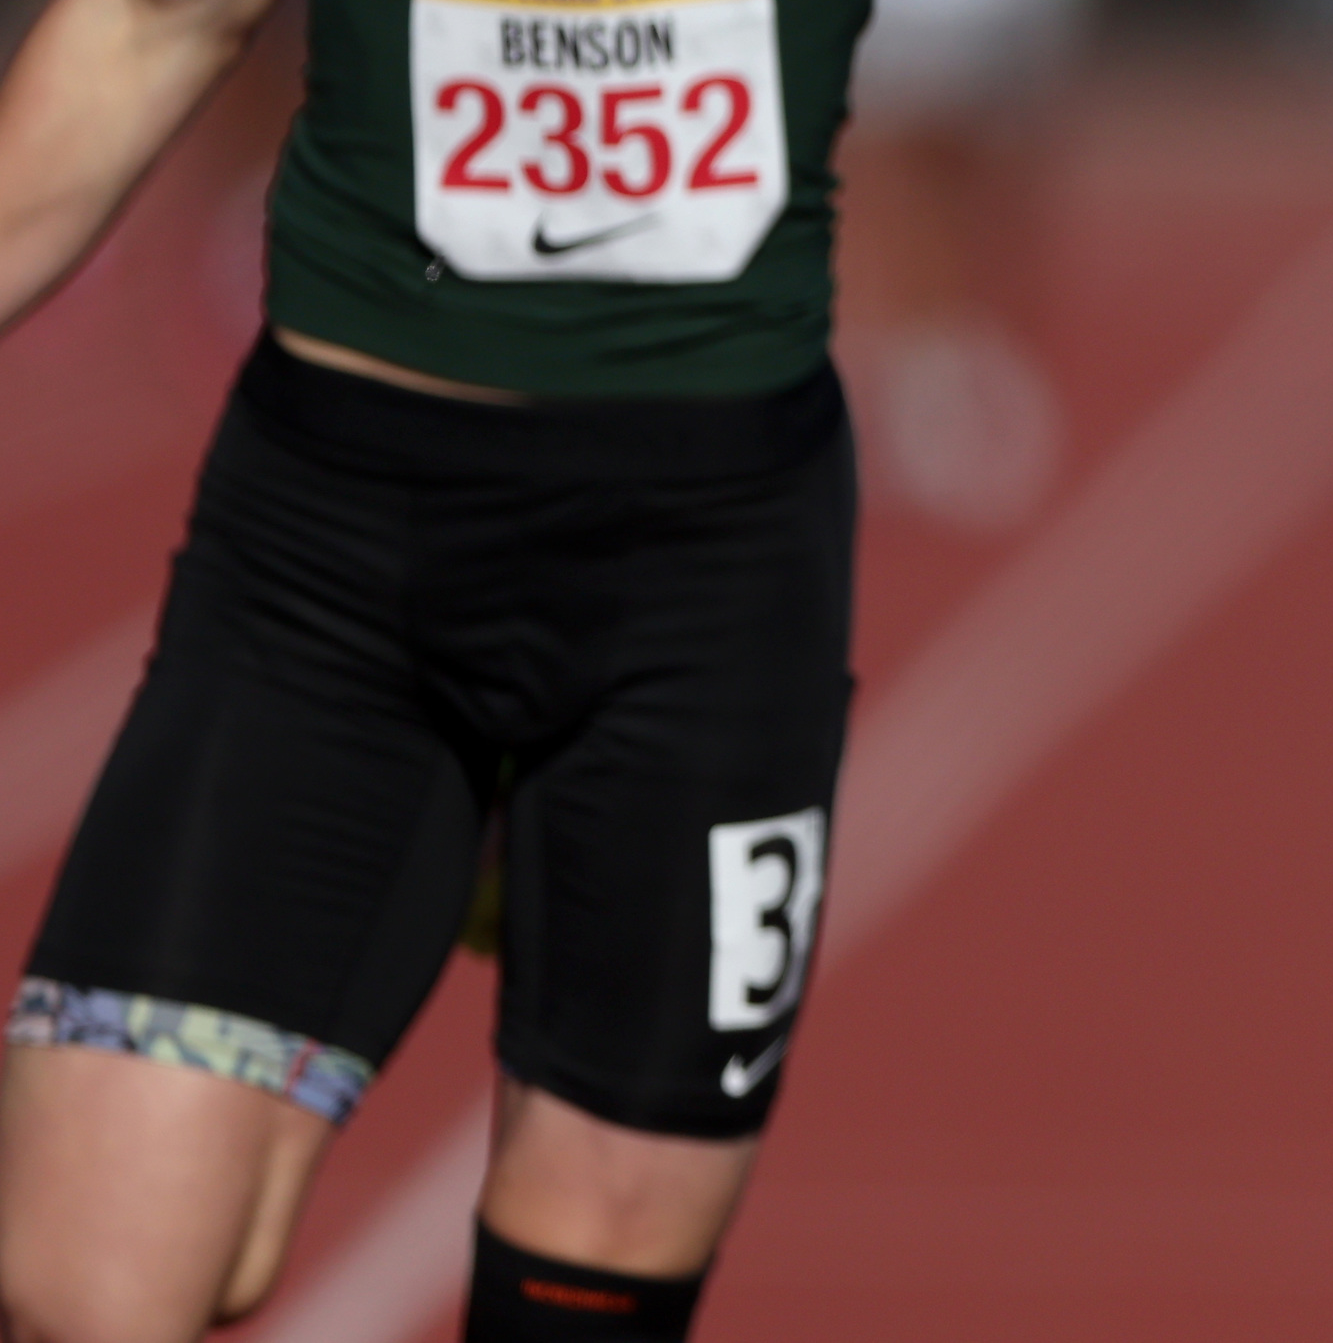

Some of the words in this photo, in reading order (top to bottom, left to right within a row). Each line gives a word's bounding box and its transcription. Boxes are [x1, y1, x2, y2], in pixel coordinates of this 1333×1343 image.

[500, 16, 675, 74] BENSON
[434, 75, 760, 201] 2352
[746, 836, 797, 1005] 3
